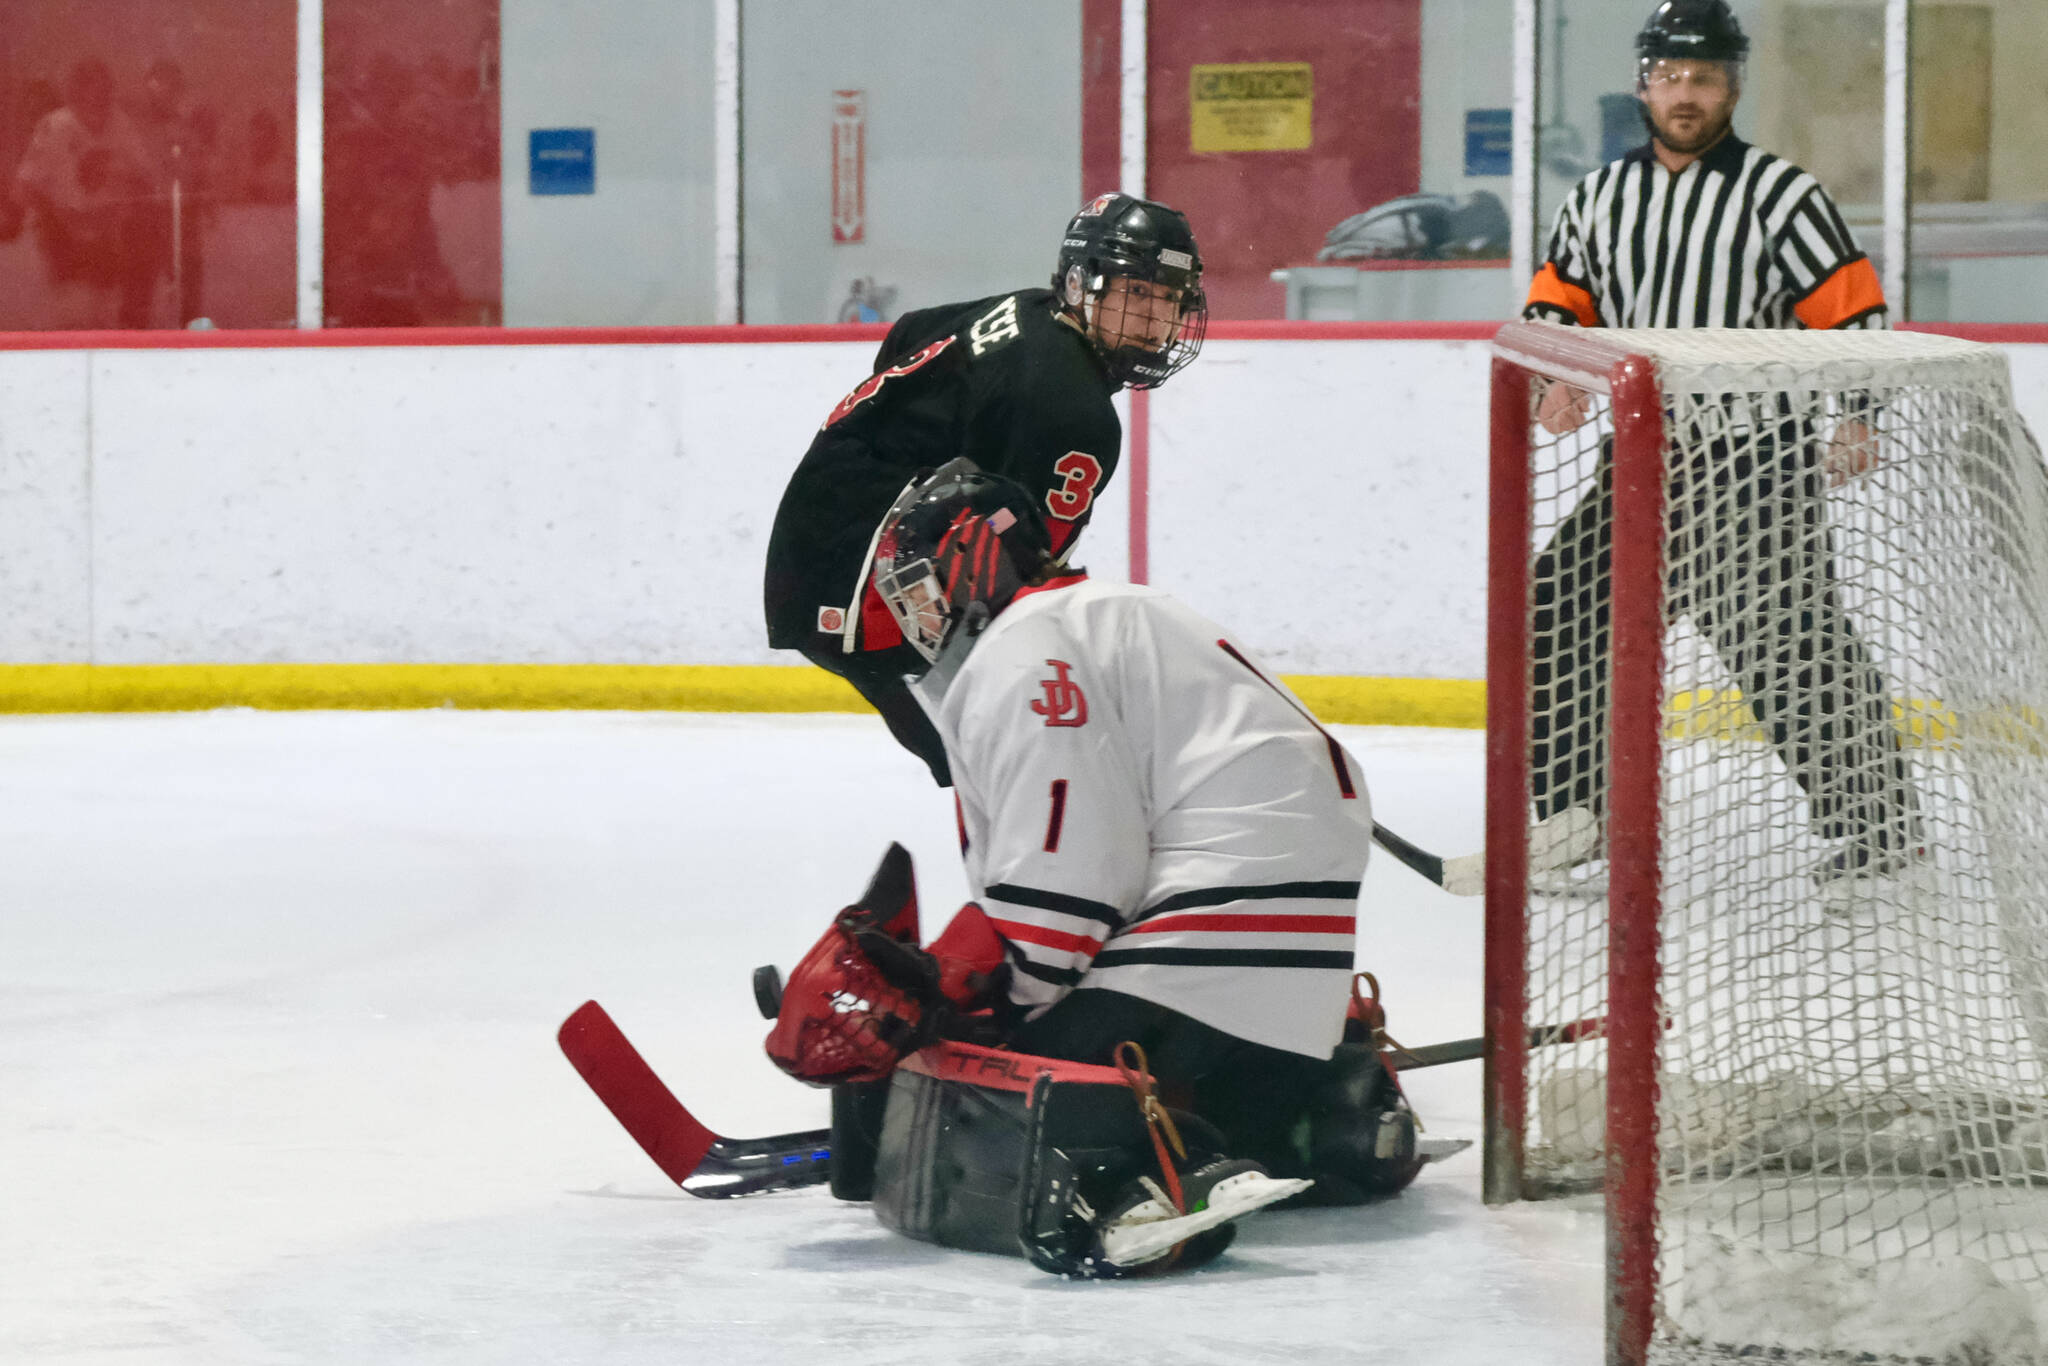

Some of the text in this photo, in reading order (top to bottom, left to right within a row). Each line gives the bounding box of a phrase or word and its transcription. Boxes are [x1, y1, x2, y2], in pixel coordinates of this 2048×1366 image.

[1063, 239, 1088, 248] CCM
[1045, 450, 1103, 520] 3
[1042, 778, 1070, 853] 1
